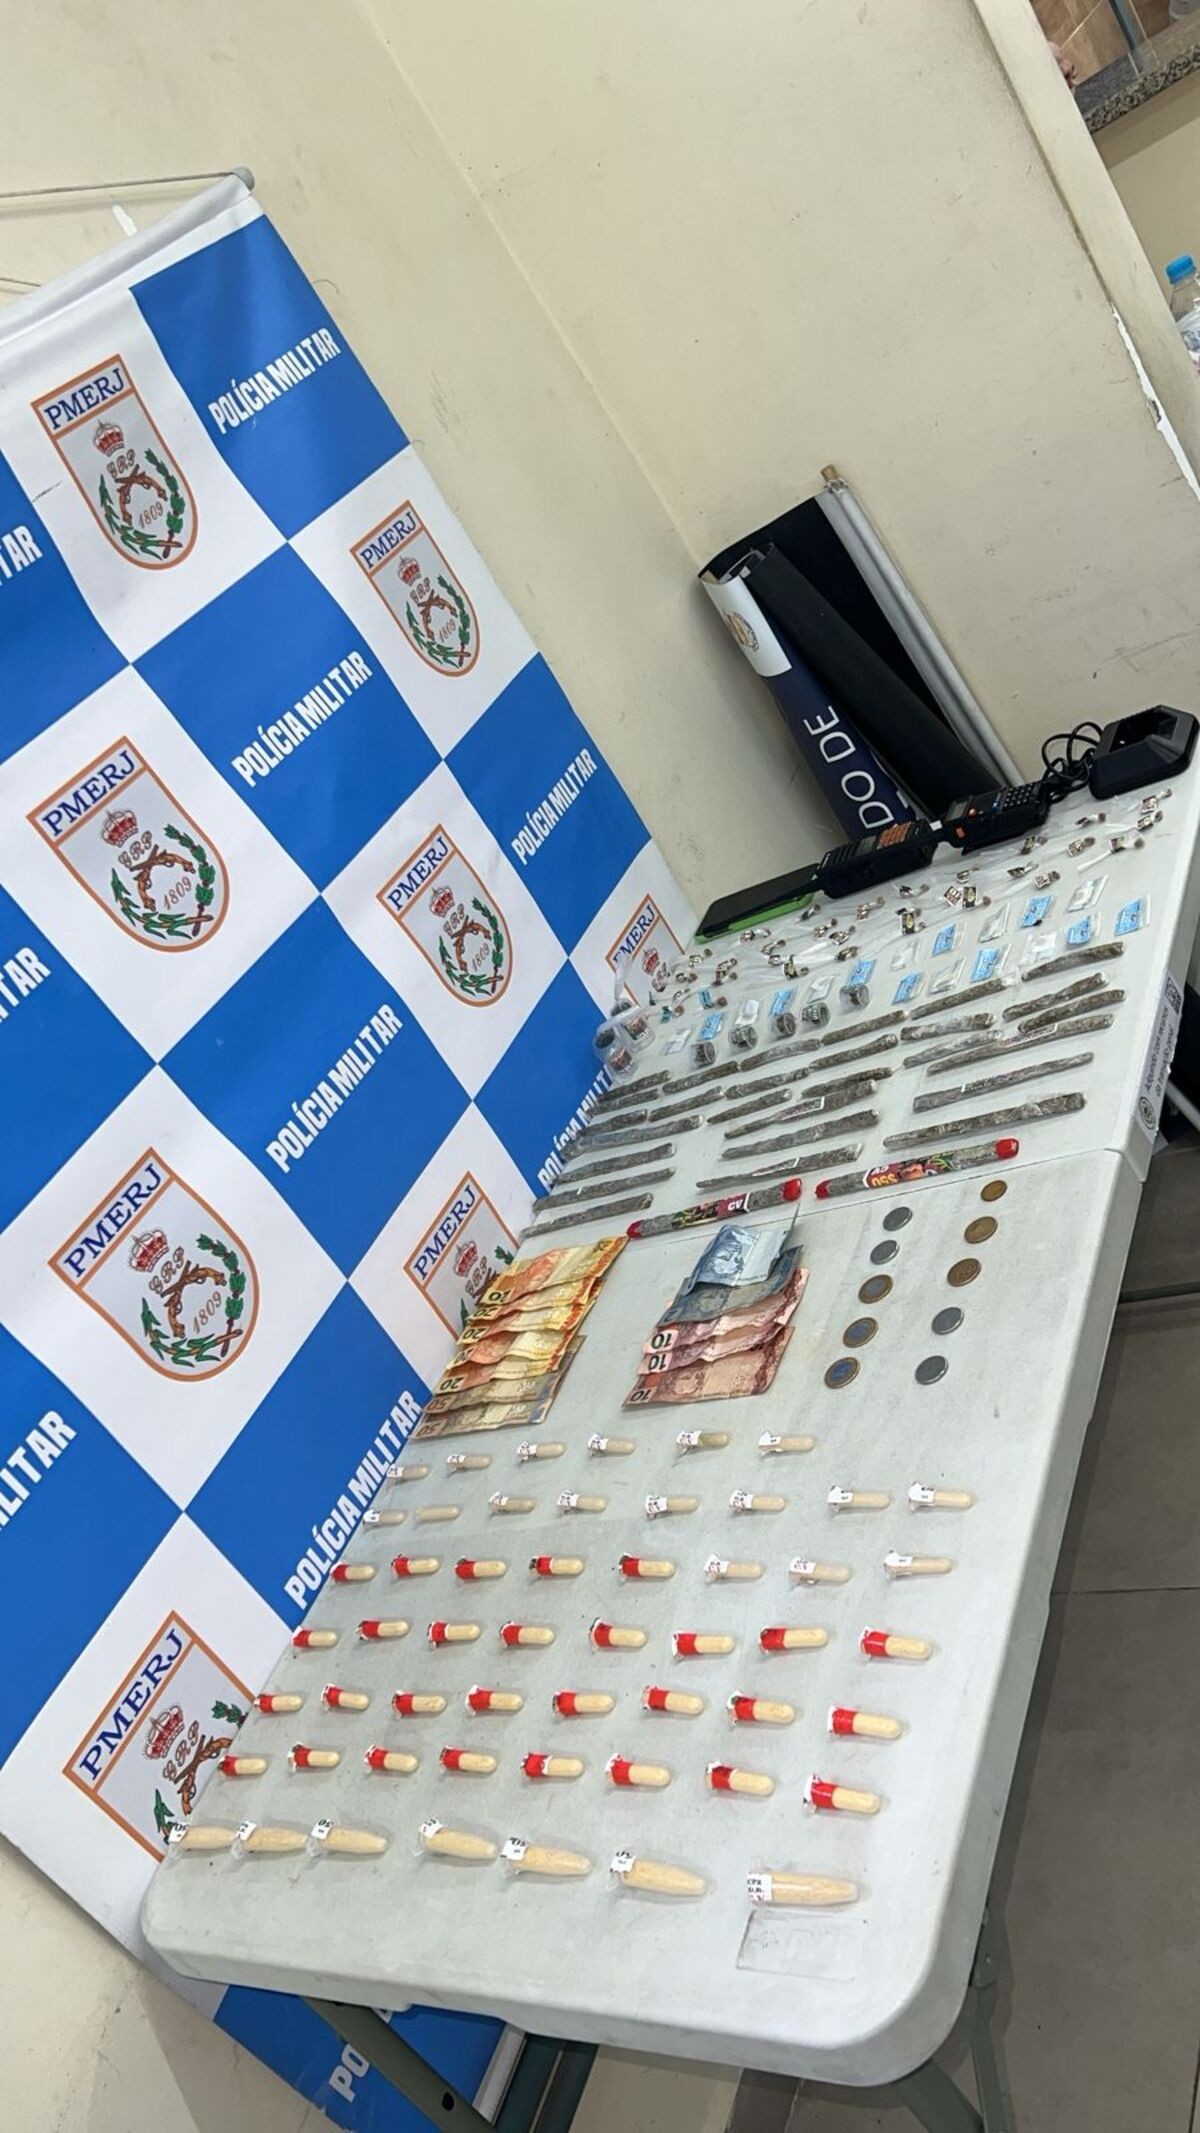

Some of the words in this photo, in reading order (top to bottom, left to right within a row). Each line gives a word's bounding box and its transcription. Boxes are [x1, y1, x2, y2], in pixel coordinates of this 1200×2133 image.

[44, 368, 125, 430] PMERJ
[208, 371, 282, 435] POLÍCIA
[265, 327, 341, 392] MILITAR
[138, 501, 164, 528] 1809
[360, 512, 417, 569] PMERJ
[231, 711, 311, 788] POLÍCIA
[293, 651, 373, 731] MILITAR
[803, 705, 856, 763] DE
[42, 750, 135, 837] PMERJ
[511, 800, 560, 866] POLÍCIA
[547, 748, 598, 817] MILITAR
[163, 876, 192, 910] 1809
[387, 836, 449, 911] PMERJ
[472, 943, 490, 971] 1809
[265, 1080, 344, 1174] POLÍCIA
[327, 1004, 404, 1098] MILITAR
[64, 1163, 162, 1278] PMERJ
[414, 1184, 476, 1280] PMERJ
[193, 1291, 222, 1334] 1809
[0, 1410, 77, 1517] LITAR
[284, 1494, 361, 1611] POLÍCIA
[347, 1390, 423, 1507] MILITAR
[80, 1628, 183, 1781] PMERJ
